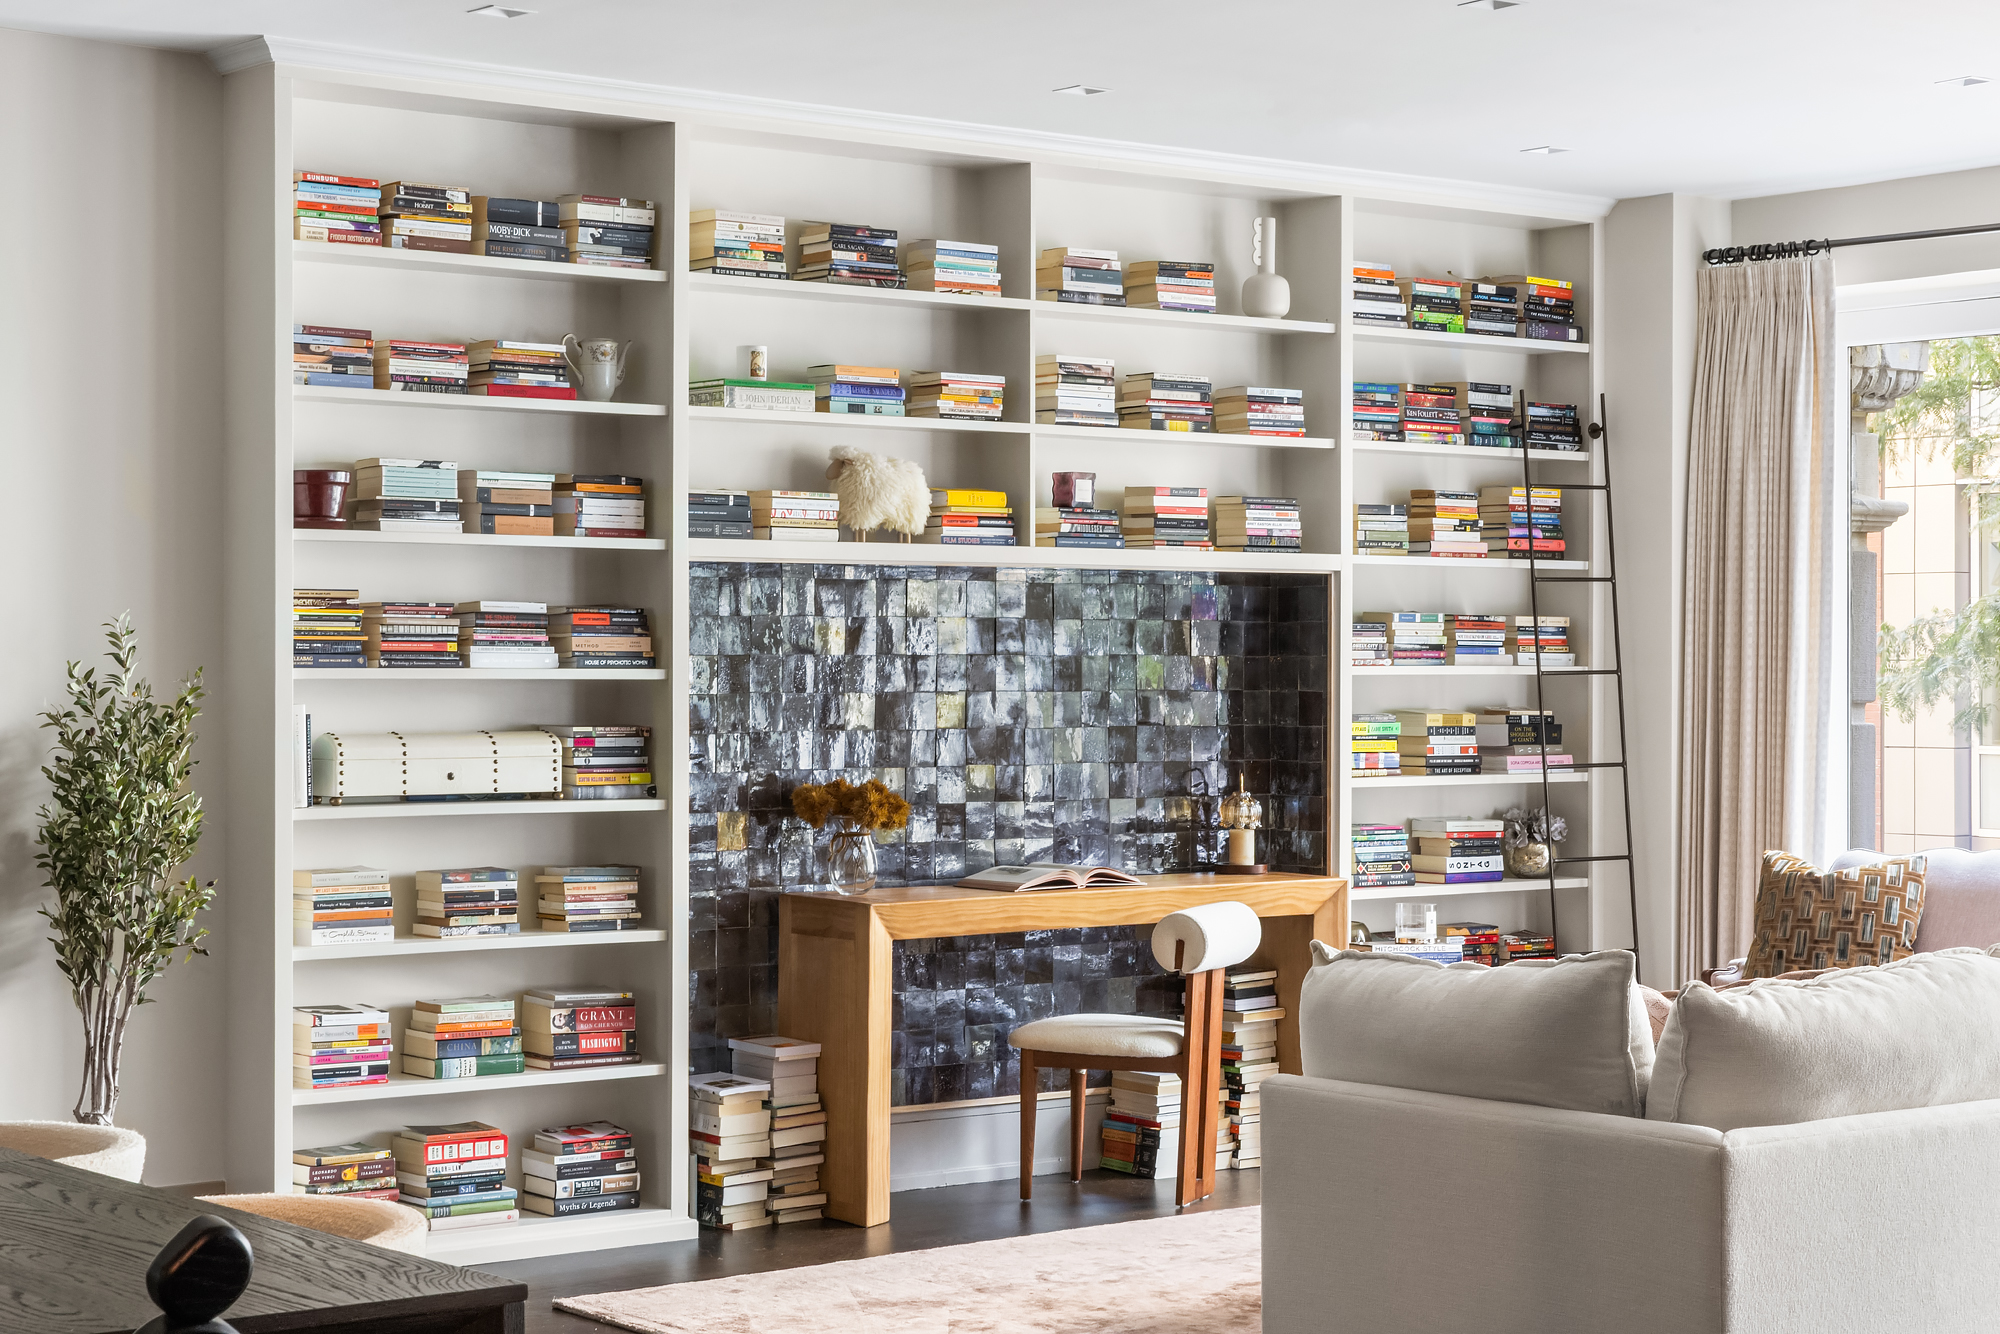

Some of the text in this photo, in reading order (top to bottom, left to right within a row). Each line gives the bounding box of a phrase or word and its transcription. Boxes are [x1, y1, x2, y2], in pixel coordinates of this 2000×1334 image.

[1449, 860, 1490, 869] SONTAG
[580, 1010, 624, 1021] GRANT
[447, 1042, 477, 1052] CHINA
[581, 1038, 620, 1048] WASHINGTON
[590, 1199, 616, 1209] Legends
